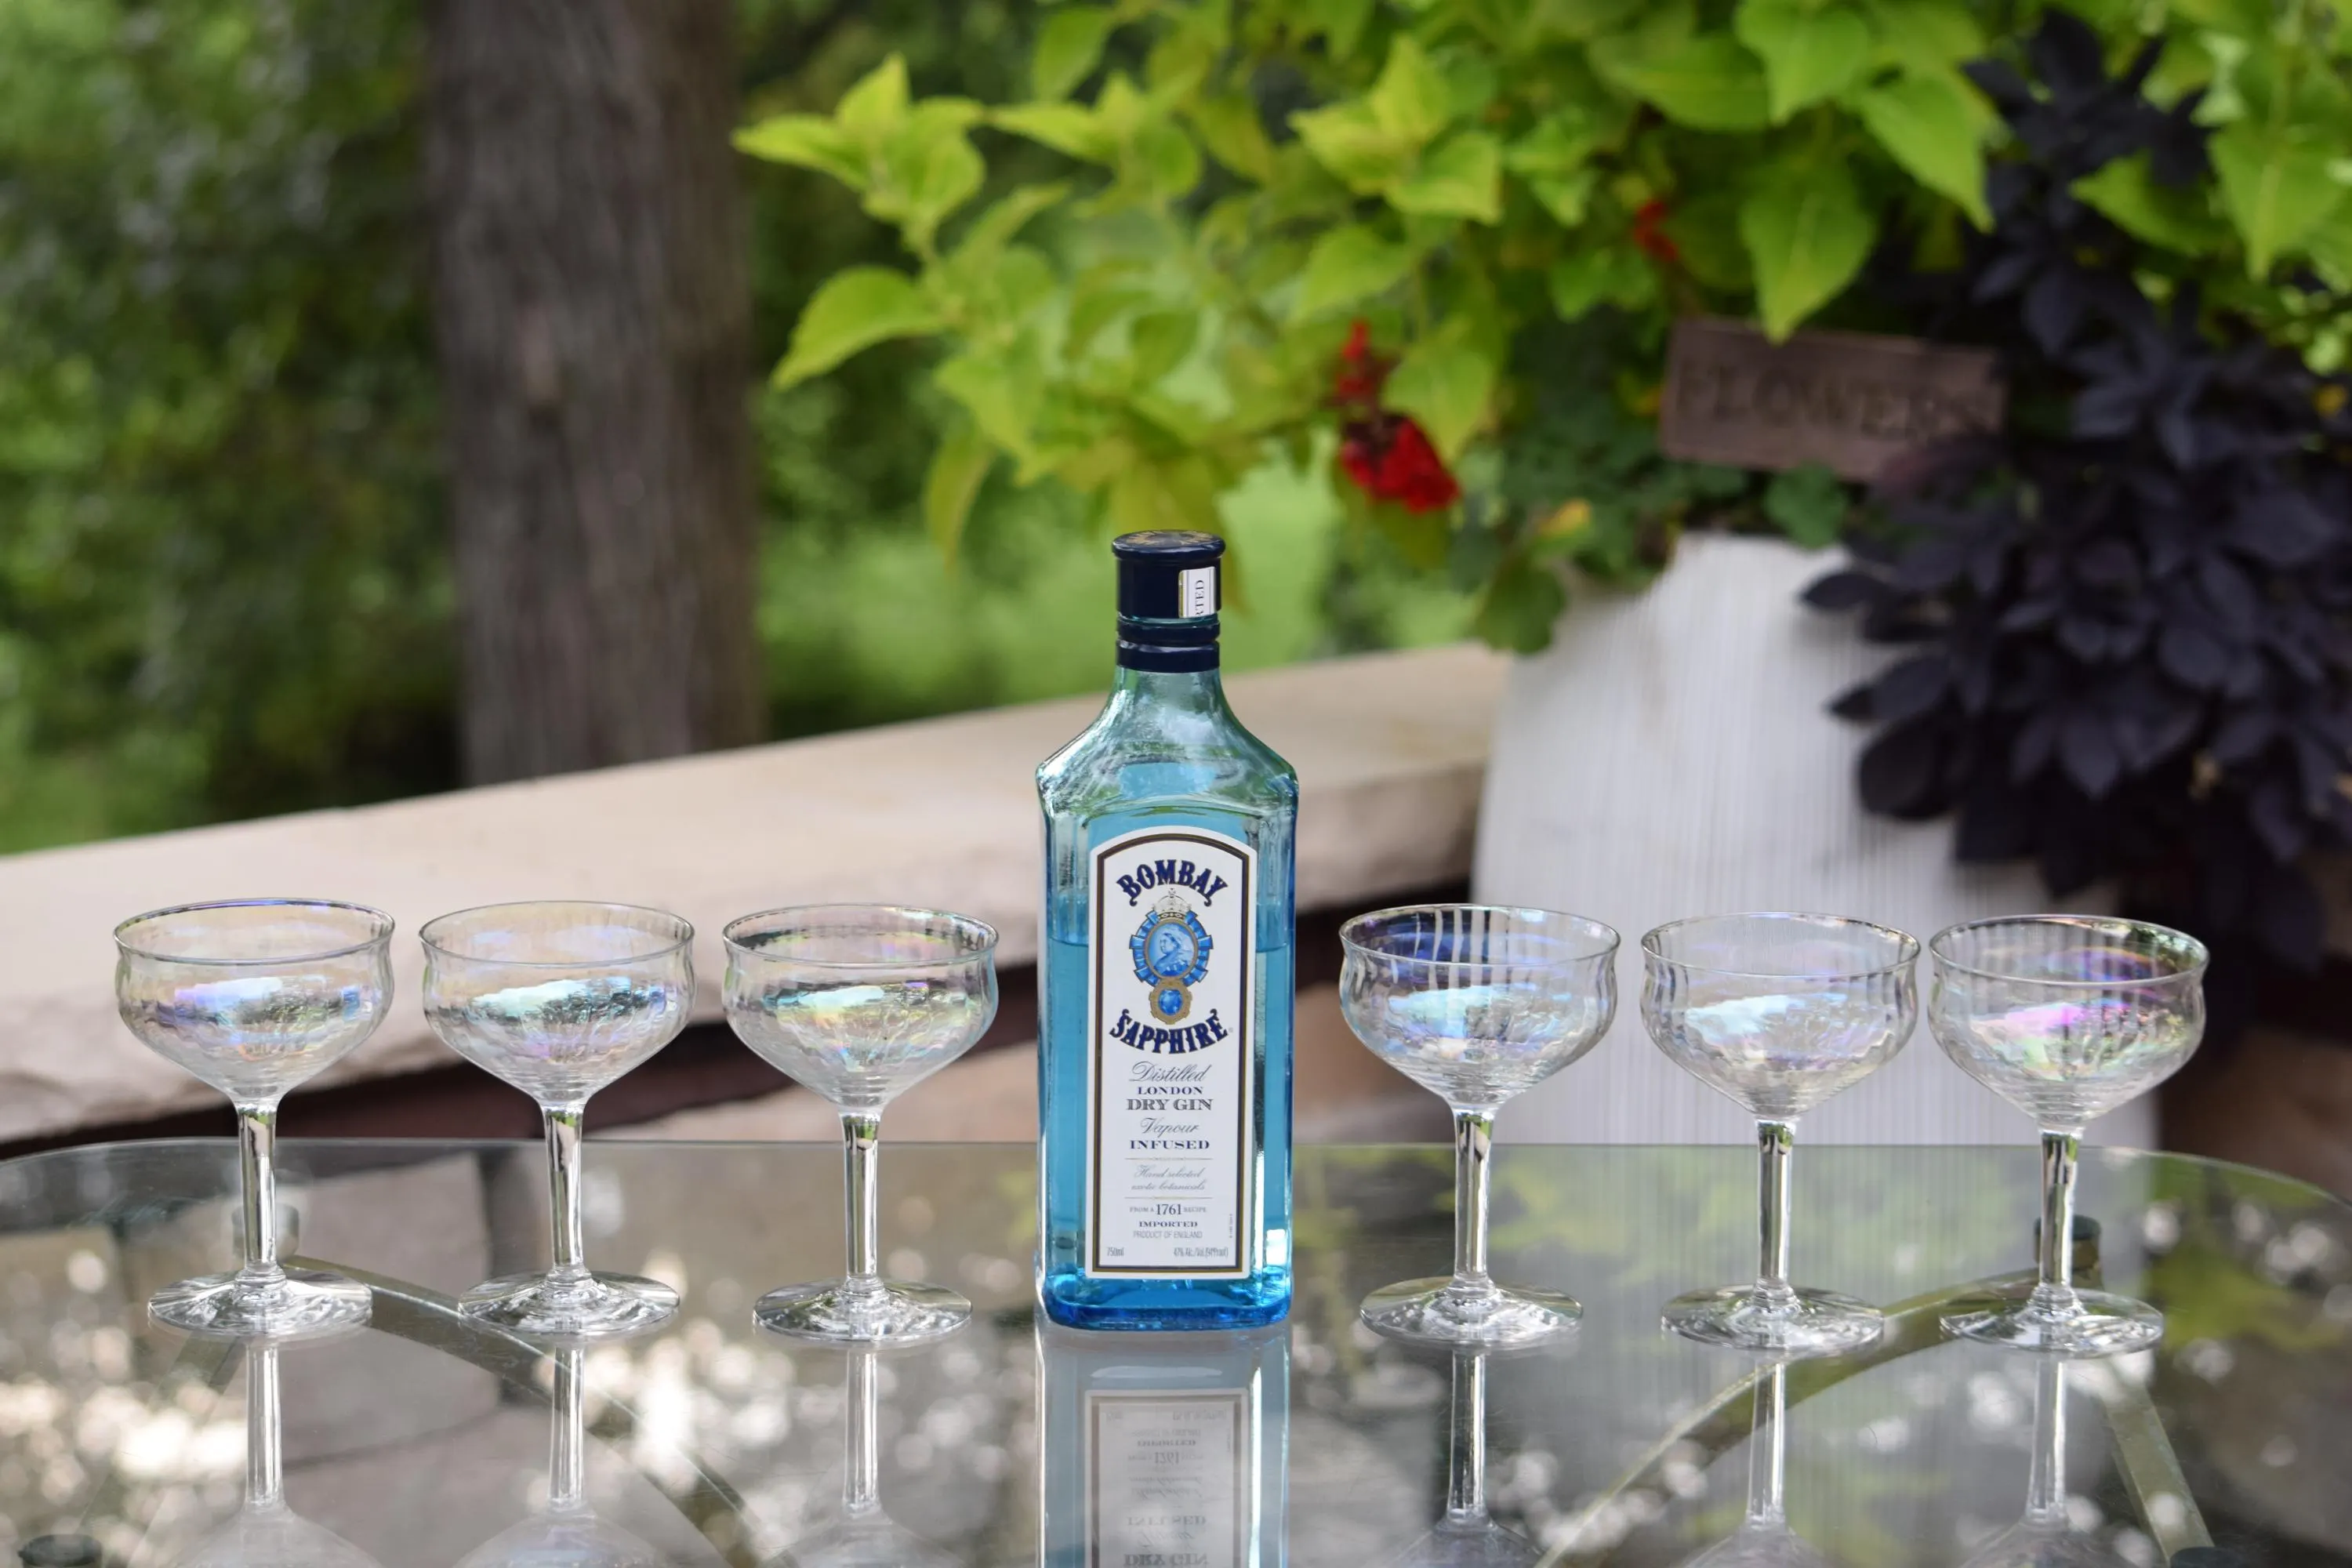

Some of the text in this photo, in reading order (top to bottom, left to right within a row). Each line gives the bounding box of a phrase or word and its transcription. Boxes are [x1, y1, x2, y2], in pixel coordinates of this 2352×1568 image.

[1116, 859, 1228, 906] BOMBAY
[1109, 1009, 1228, 1054] SAPPHIRE
[1129, 1061, 1212, 1082] Distilled
[1138, 1087, 1203, 1095] LONDON
[1127, 1098, 1214, 1111] DRY GIN
[1140, 1117, 1199, 1138] Vapour
[1130, 1140, 1210, 1149] INFUSED
[1134, 1165, 1206, 1178] Hand selected
[1159, 1180, 1207, 1191] botanicals
[1156, 1203, 1181, 1215] 1761
